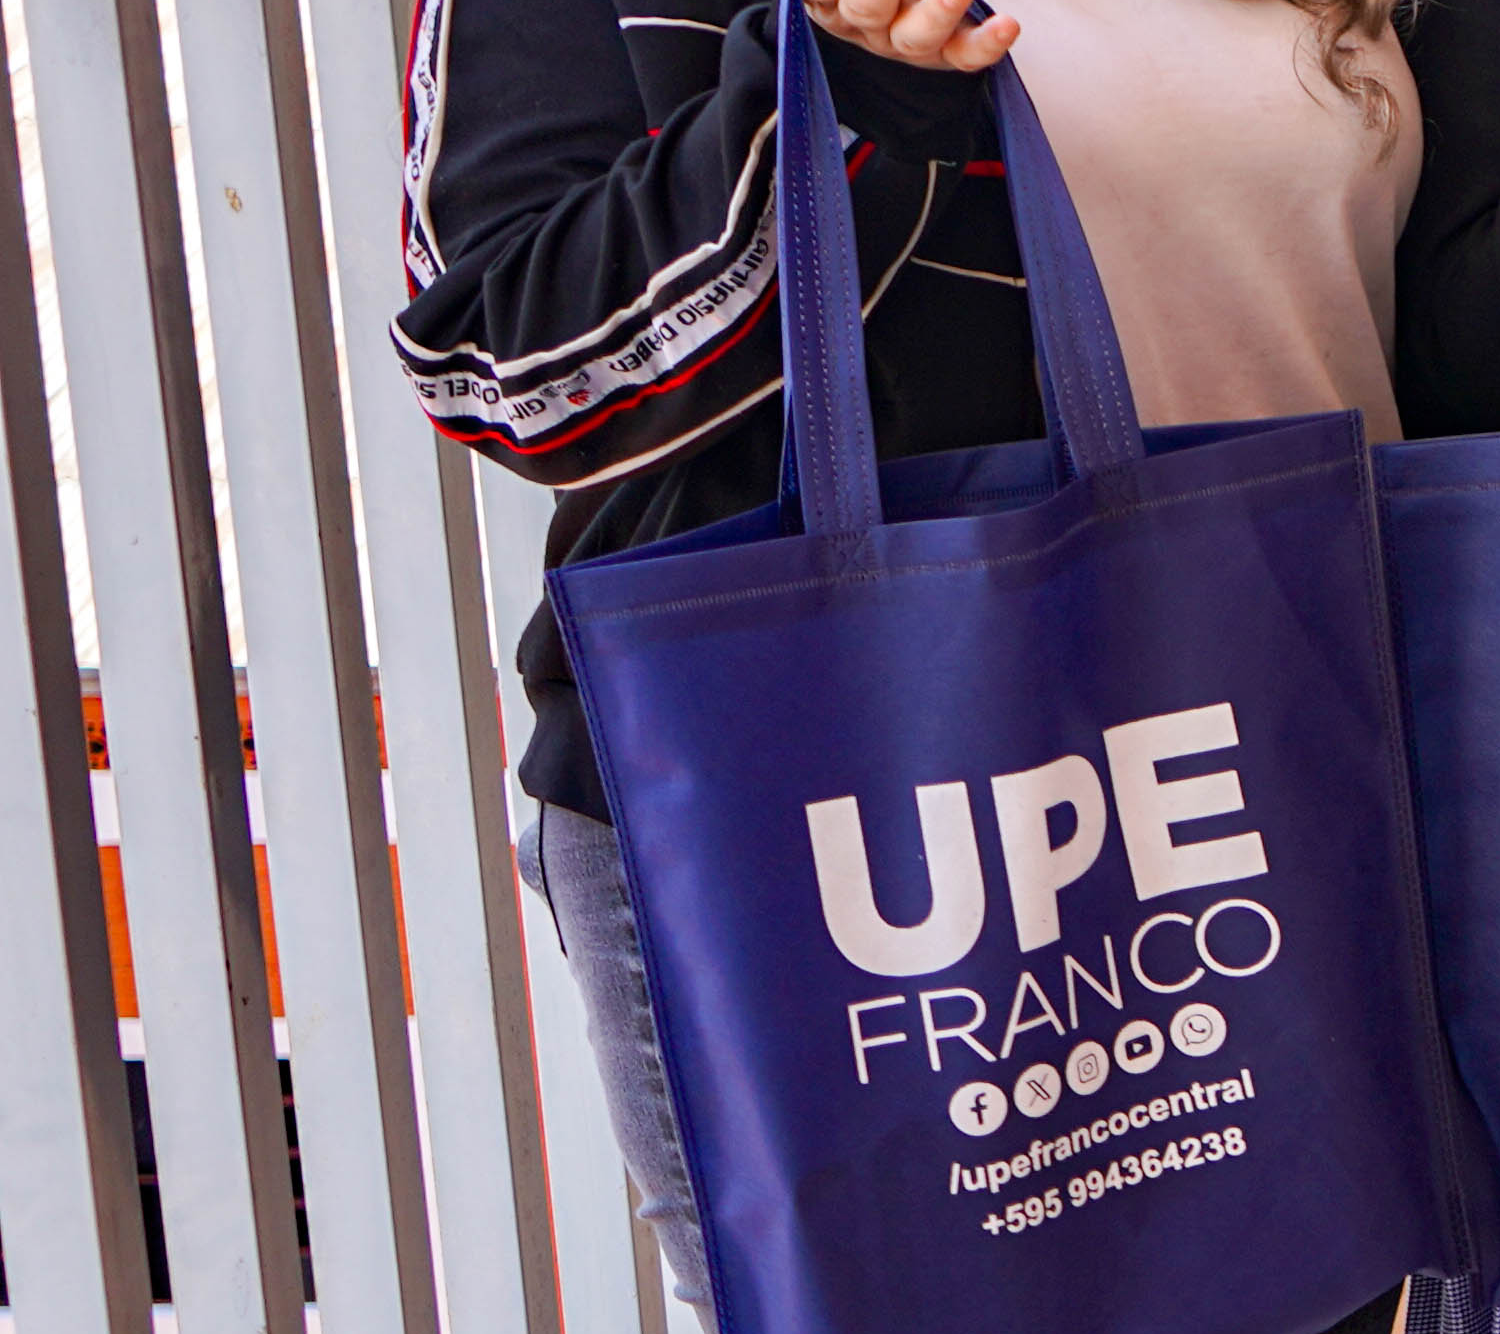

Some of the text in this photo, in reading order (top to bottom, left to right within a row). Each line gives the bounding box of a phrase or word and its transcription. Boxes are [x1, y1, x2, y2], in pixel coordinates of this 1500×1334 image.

[805, 701, 1270, 977] UPE
[847, 898, 1282, 1085] FRANCO
[950, 1069, 1256, 1196] /upefrancocentral
[981, 1126, 1249, 1236] +595 994364238
